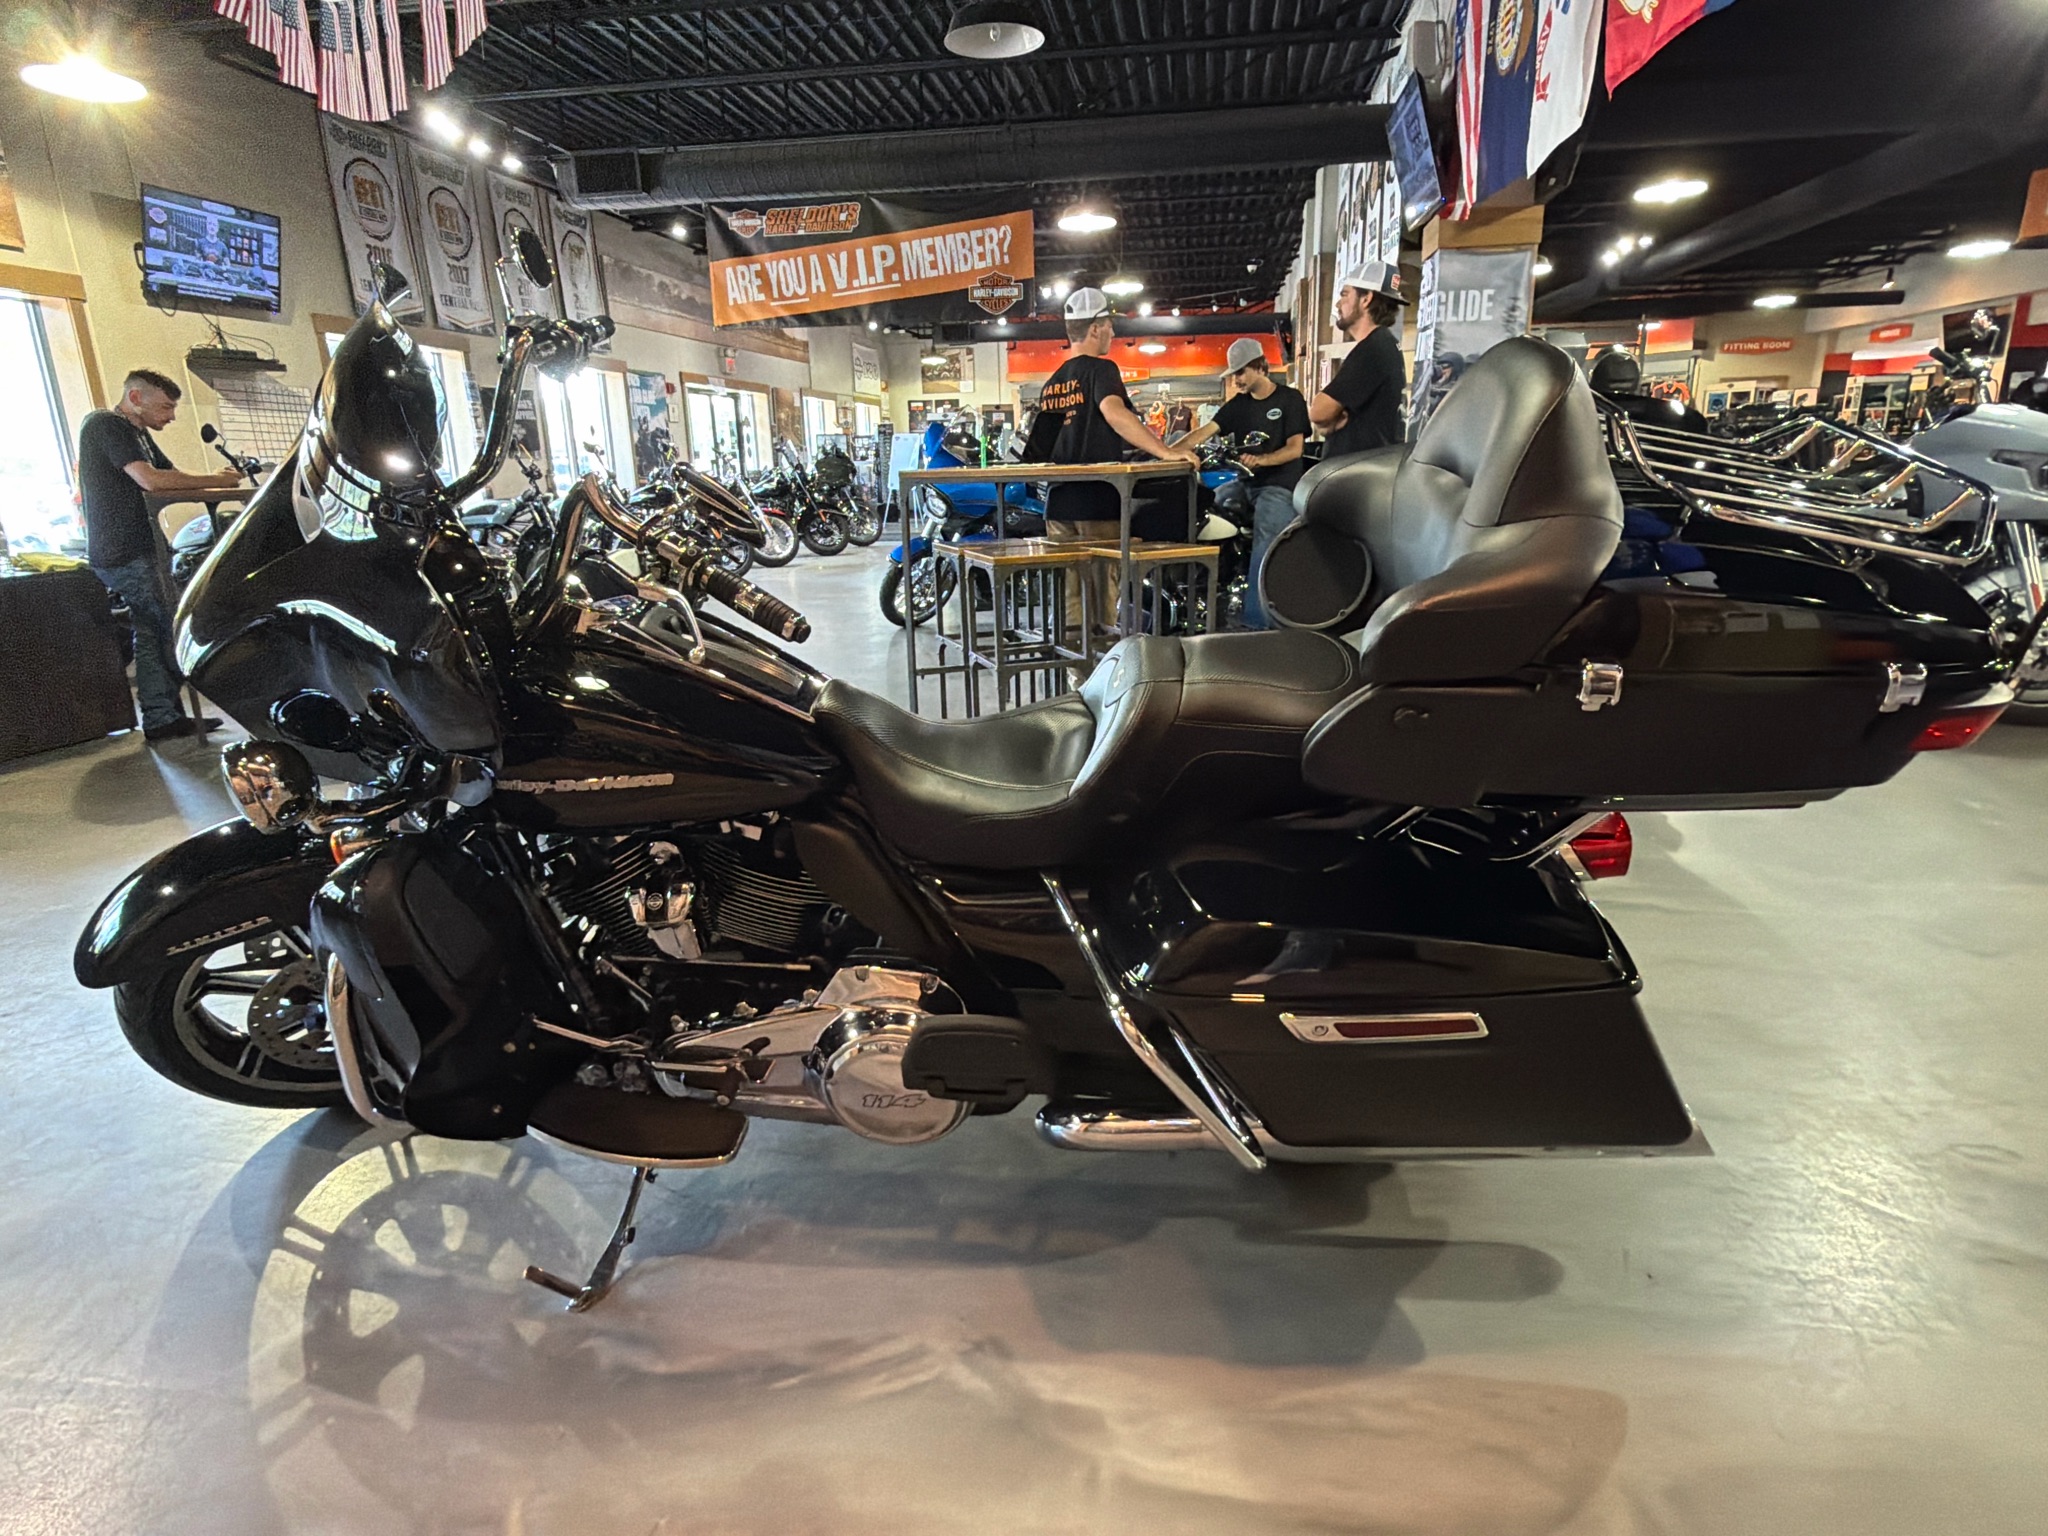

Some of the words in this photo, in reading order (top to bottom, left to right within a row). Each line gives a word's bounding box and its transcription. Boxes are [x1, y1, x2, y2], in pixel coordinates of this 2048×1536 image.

[765, 203, 860, 225] SHELDON'S
[765, 221, 852, 234] HARLEY-DAVIDSON
[725, 263, 766, 306] ARE
[765, 256, 807, 299] YOU
[809, 254, 826, 294] A
[827, 244, 900, 290] V.I.P.
[900, 225, 1012, 281] MEMBER?
[1437, 289, 1496, 322] GLIDE
[1723, 342, 1760, 351] FITTING
[1762, 341, 1791, 349] ROOM
